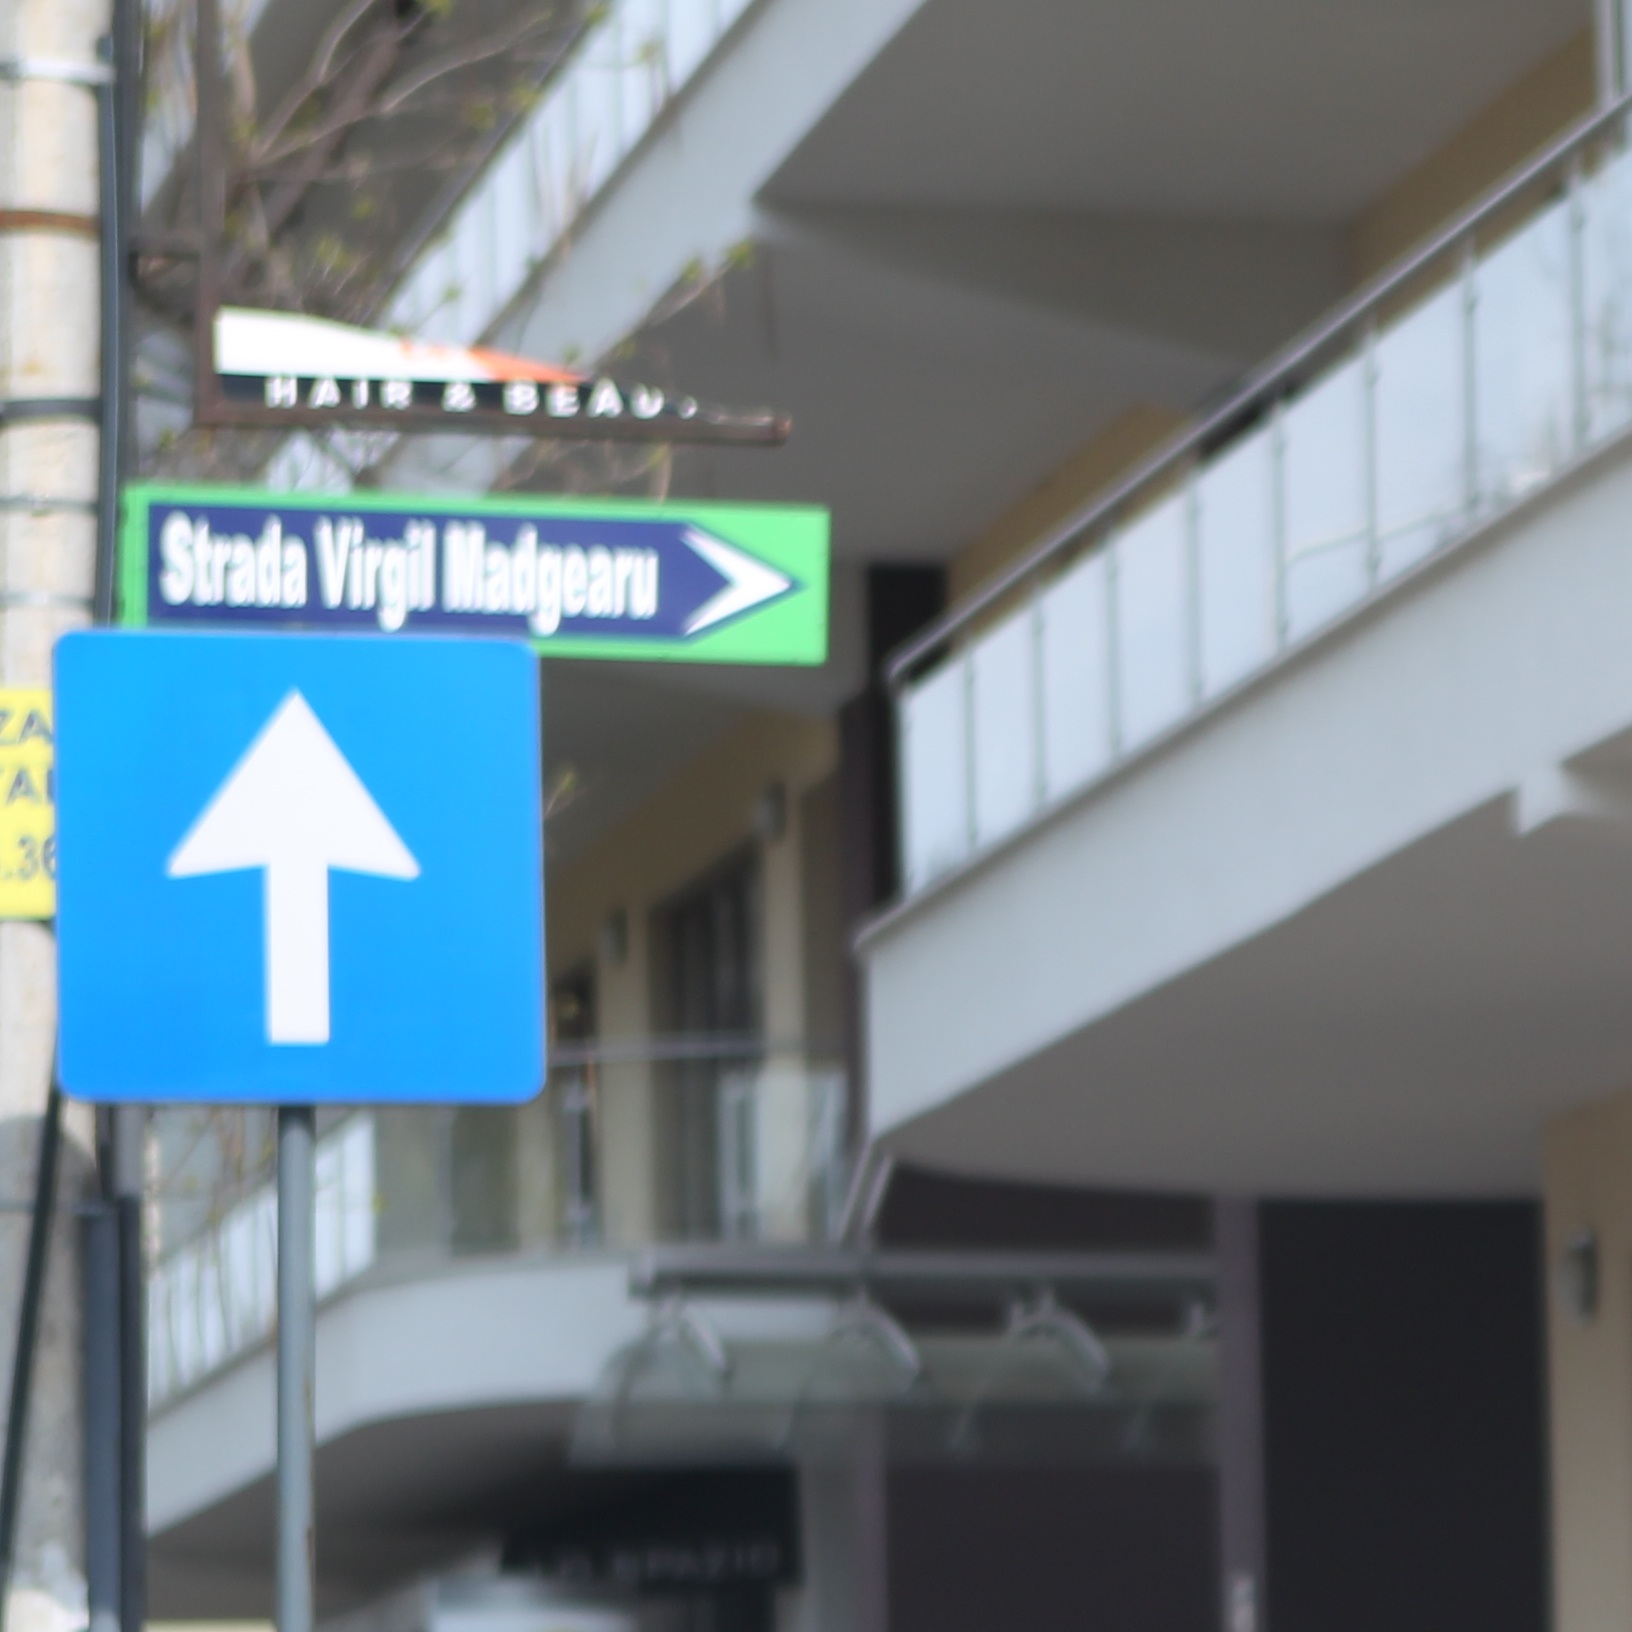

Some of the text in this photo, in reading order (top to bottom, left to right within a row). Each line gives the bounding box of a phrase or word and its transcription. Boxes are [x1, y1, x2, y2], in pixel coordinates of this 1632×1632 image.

[265, 374, 413, 409] HAIR
[442, 381, 476, 412] &
[160, 511, 659, 636] Strada Virgil Madgearu
